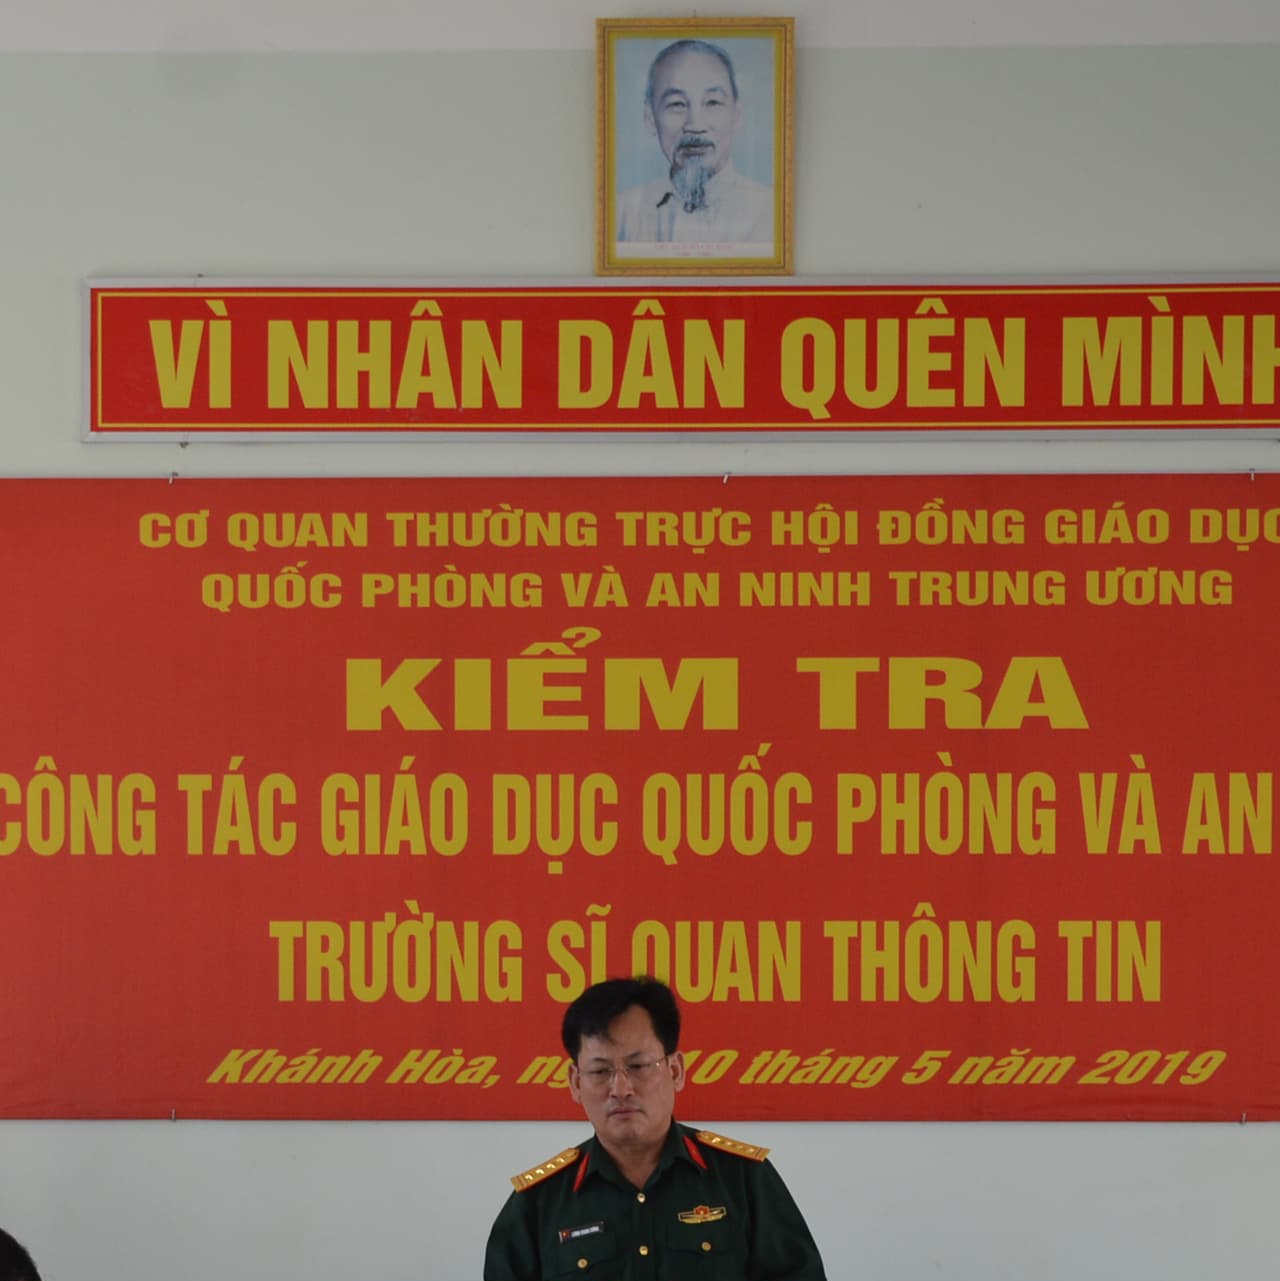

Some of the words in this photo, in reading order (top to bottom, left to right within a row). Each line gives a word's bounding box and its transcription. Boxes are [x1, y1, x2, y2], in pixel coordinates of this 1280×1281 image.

[149, 300, 231, 408] VÌ
[268, 300, 522, 408] NHÂN
[558, 299, 745, 408] DÂN
[781, 297, 1025, 419] QUÊN
[139, 509, 209, 548] CƠ
[227, 512, 368, 552] QUAN
[386, 503, 597, 547] THƯỜNG
[616, 508, 751, 554] TRỰC
[772, 503, 858, 553] HỘI
[877, 498, 1024, 545] ĐỒNG
[1045, 502, 1169, 544] GIÁO
[202, 561, 342, 612] QUỐC
[362, 564, 542, 608] PHÒNG
[560, 565, 628, 607] VÀ
[646, 572, 720, 607] AN
[740, 572, 870, 606] NINH
[889, 570, 1065, 606] TRUNG
[1086, 567, 1232, 605] ƯƠNG
[346, 626, 739, 731] KIỂM
[796, 656, 1089, 730] TRA
[178, 755, 297, 856] TÁC
[321, 755, 468, 856] GIÁO
[492, 772, 618, 875] DỤC
[643, 743, 812, 865] QUỐC
[837, 752, 1056, 855] PHÒNG
[1079, 754, 1162, 854] VÀ
[1183, 772, 1272, 854] AN
[269, 899, 522, 1003] TRƯỜNG
[546, 904, 611, 1003] SĨ
[632, 920, 801, 1003] QUAN
[824, 902, 1036, 1003] THÔNG
[1058, 920, 1161, 1002] TIN
[207, 1048, 383, 1084] Khánh
[385, 1048, 500, 1088] Hòa,
[739, 1048, 899, 1088] tháng
[902, 1050, 951, 1084] 5
[948, 1048, 1076, 1085] năm
[1078, 1050, 1227, 1085] 2019
